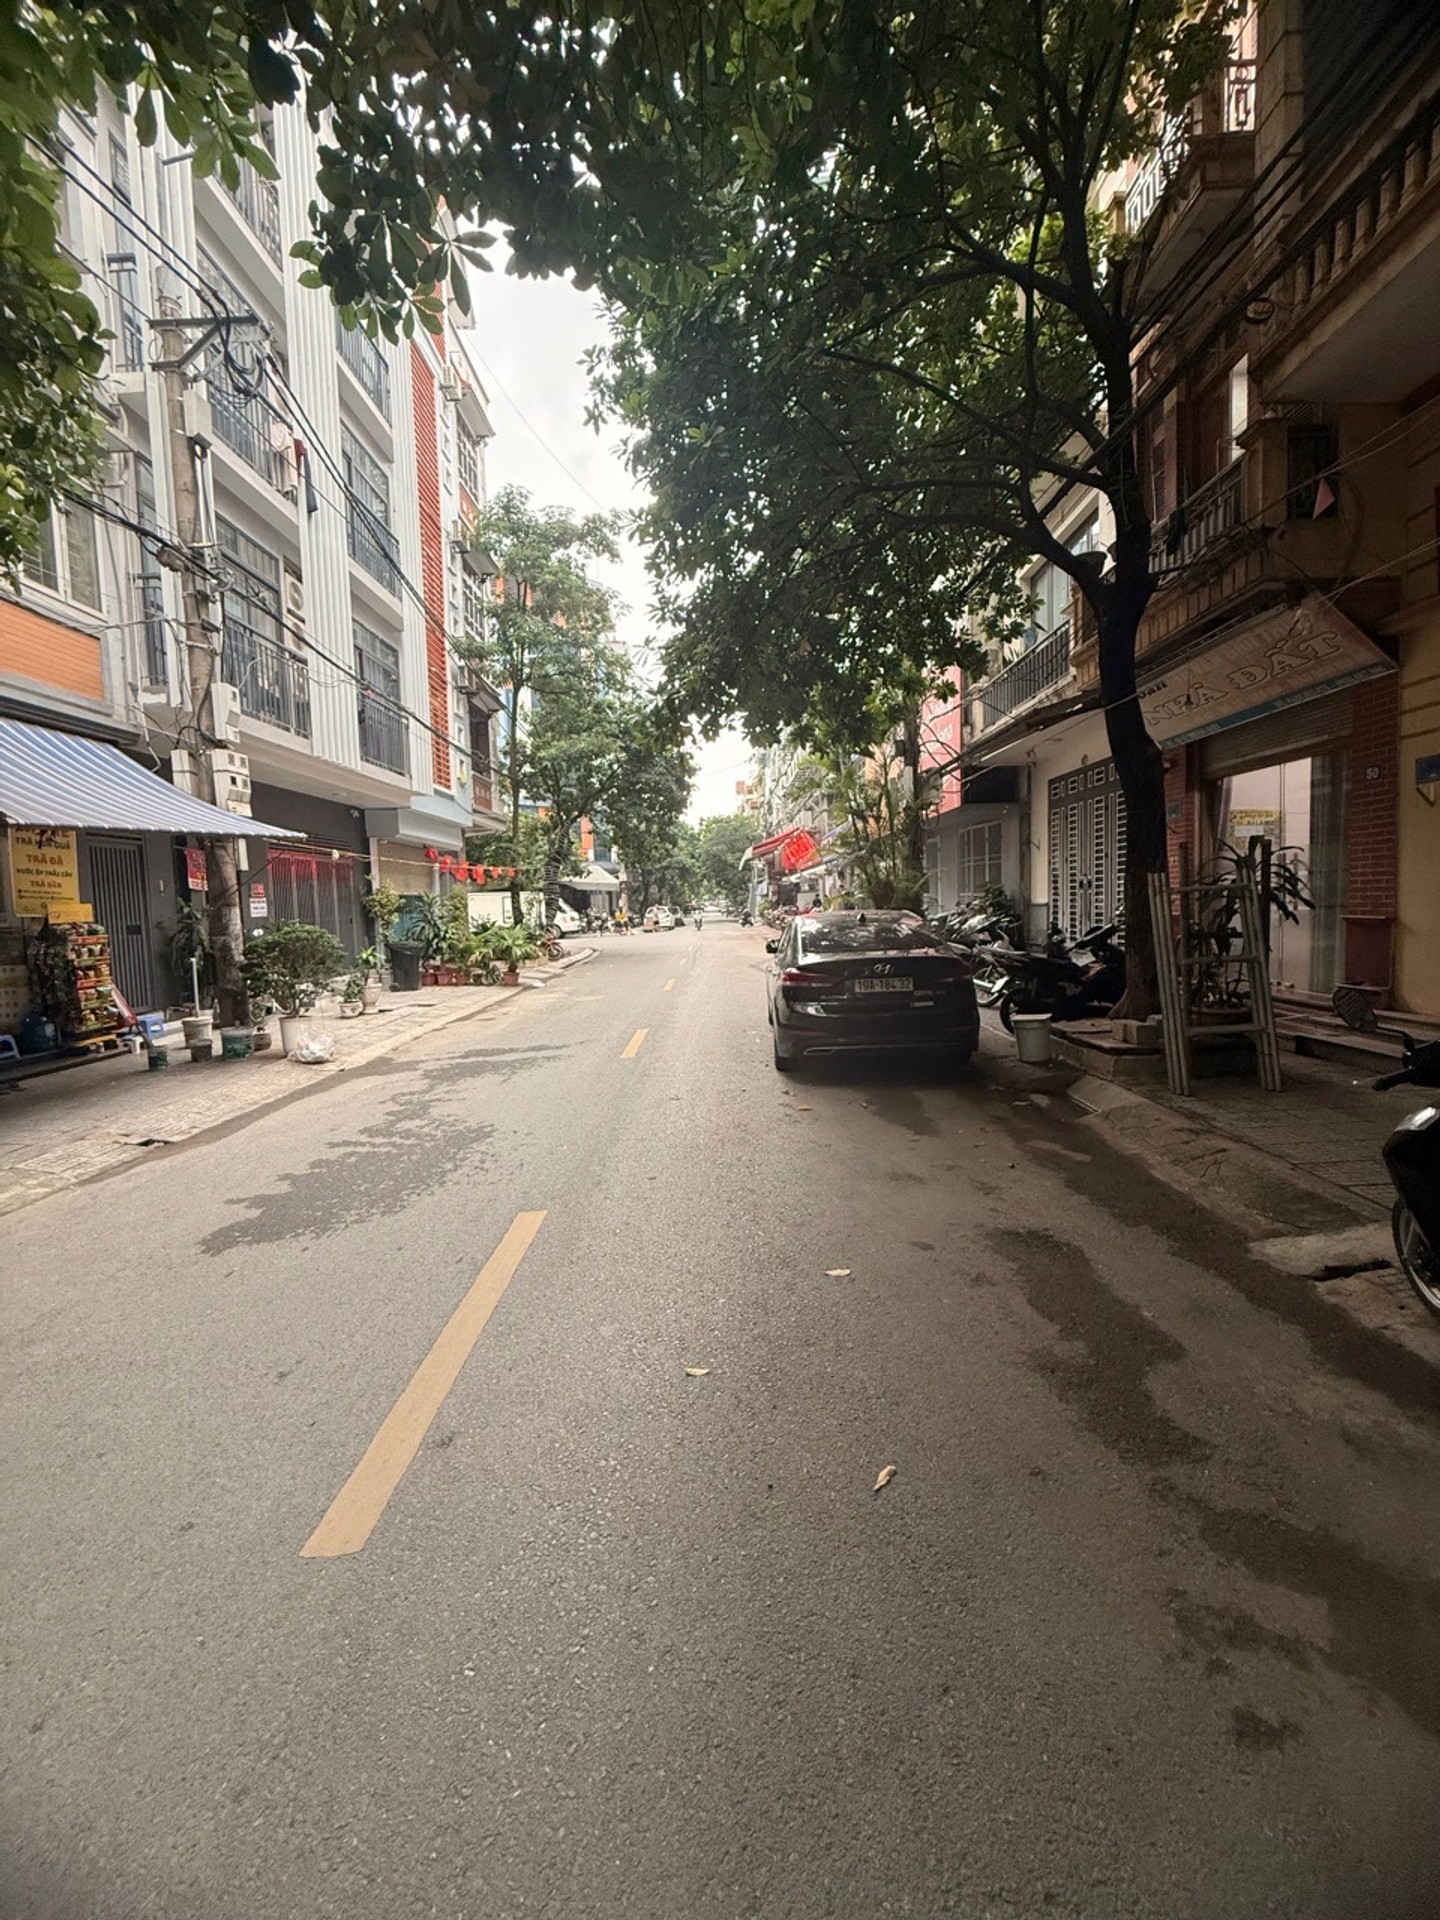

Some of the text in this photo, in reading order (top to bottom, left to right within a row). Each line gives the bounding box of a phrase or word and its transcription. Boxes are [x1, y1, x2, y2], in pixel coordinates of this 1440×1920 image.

[1142, 682, 1228, 725] NHÀ
[1226, 631, 1341, 690] ĐẤT
[1366, 767, 1379, 780] 50
[26, 853, 47, 865] TRÀ
[30, 879, 46, 888] TRÀ
